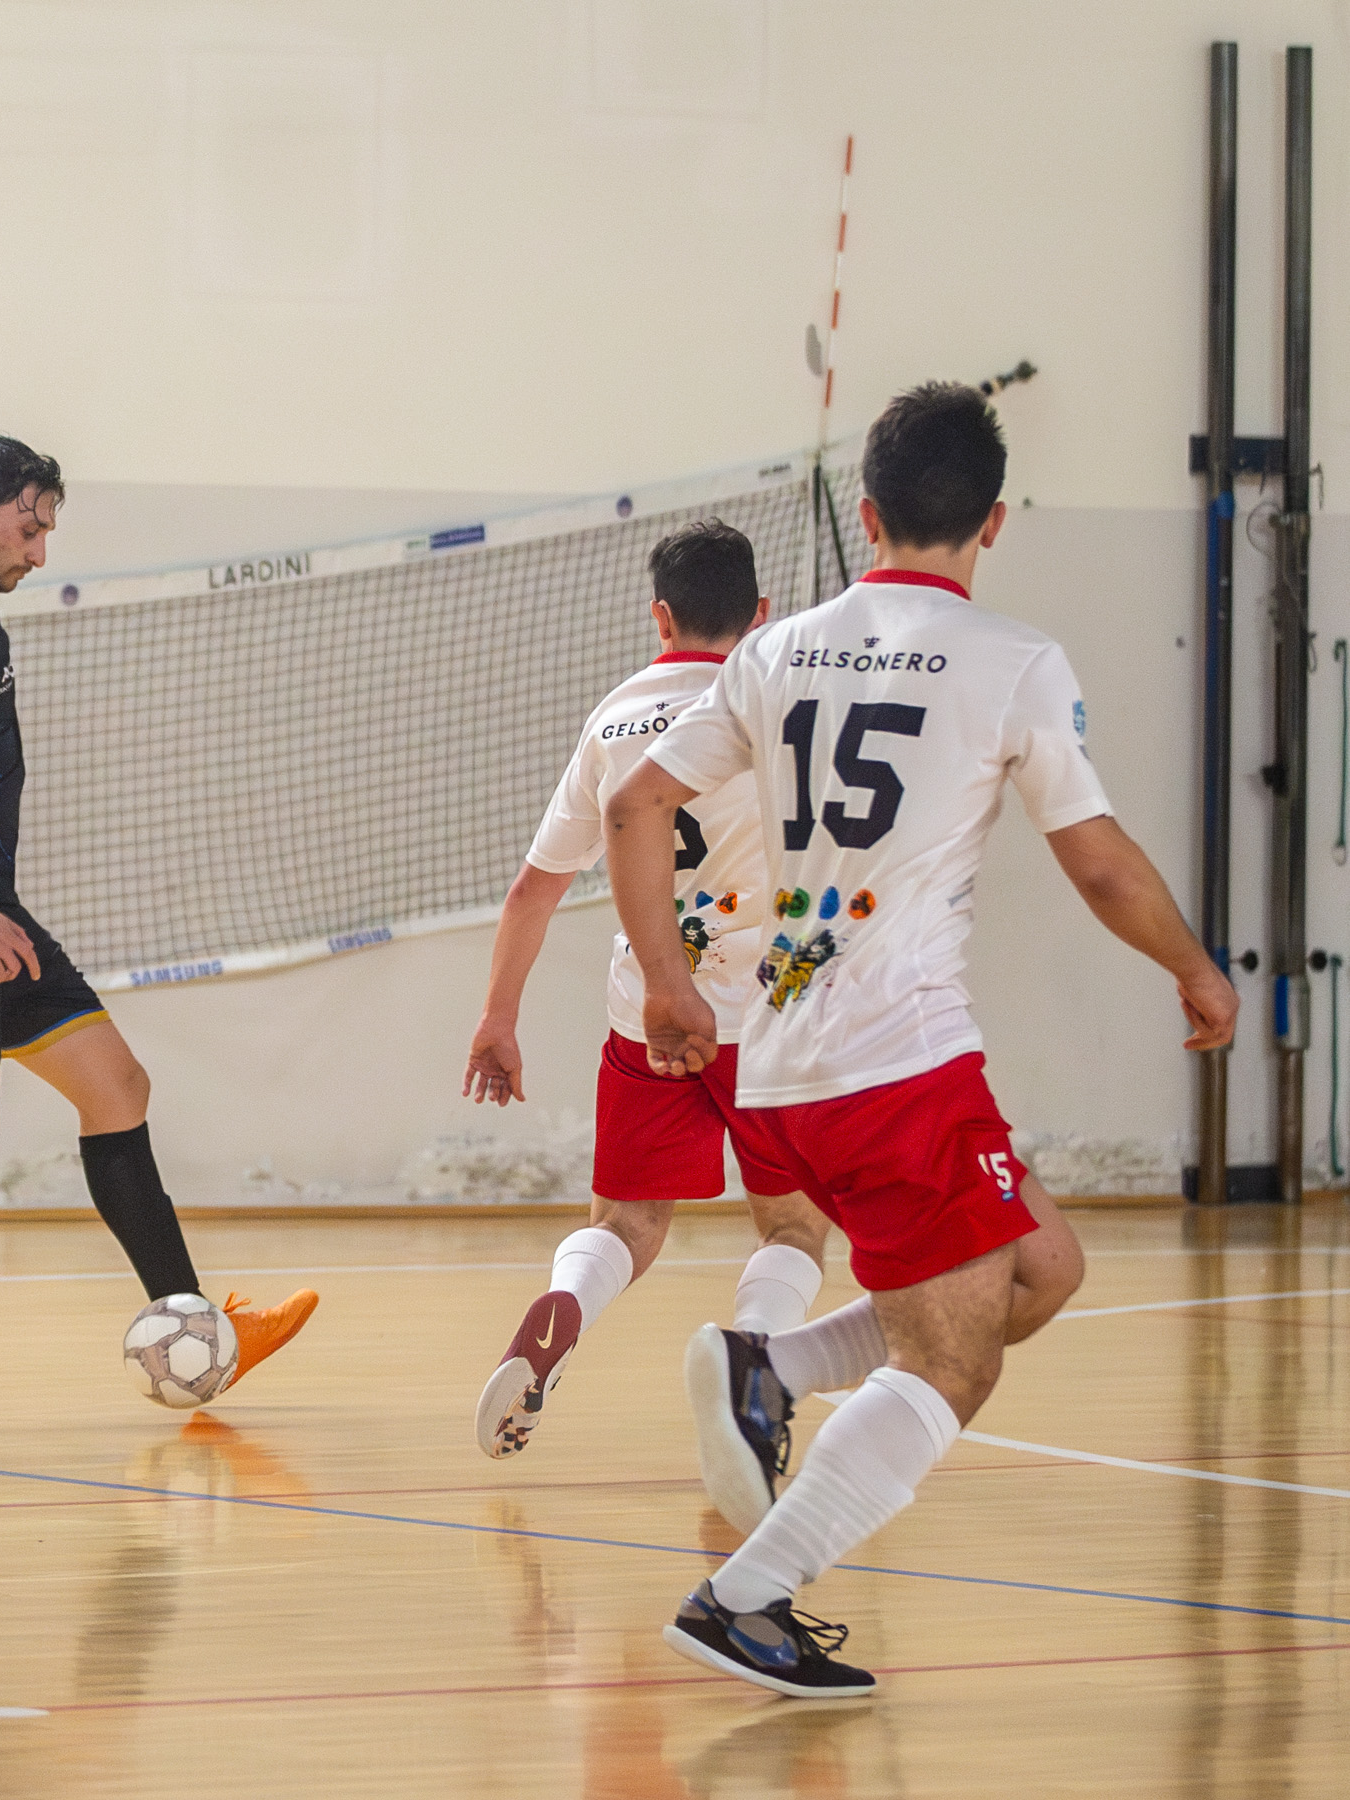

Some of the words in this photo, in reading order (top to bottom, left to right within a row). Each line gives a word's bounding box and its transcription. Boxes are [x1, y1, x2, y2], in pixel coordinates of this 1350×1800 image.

[208, 551, 311, 589] LARDINI
[790, 649, 947, 673] GELSONERO
[601, 716, 676, 739] GELSO
[782, 699, 927, 850] 15
[129, 960, 223, 986] SAMSUNG
[977, 1151, 1013, 1191] 15
